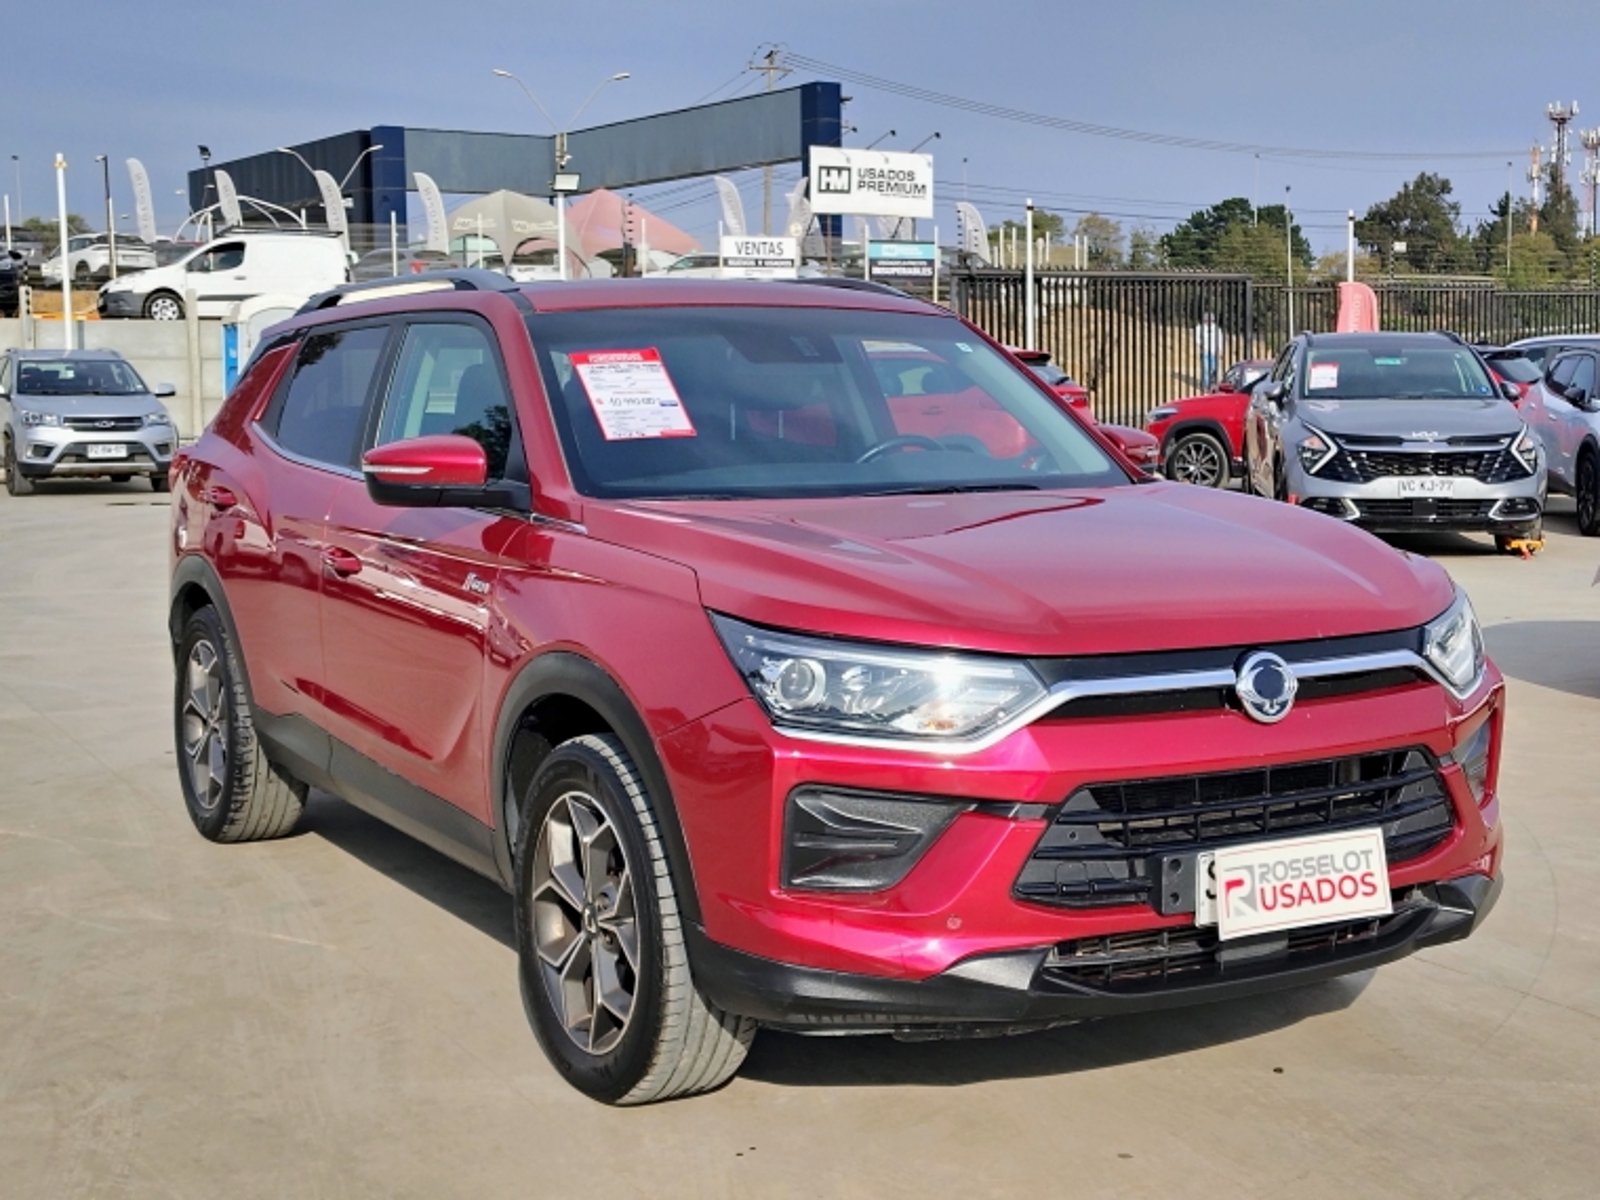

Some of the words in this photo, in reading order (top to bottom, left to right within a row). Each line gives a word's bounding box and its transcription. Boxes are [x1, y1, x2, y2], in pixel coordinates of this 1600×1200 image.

[858, 168, 915, 181] USADOS
[858, 181, 927, 194] PREMIUM
[735, 241, 784, 256] VENTAS
[1258, 849, 1373, 884] ROSSELOT
[1259, 872, 1378, 911] USADOS
